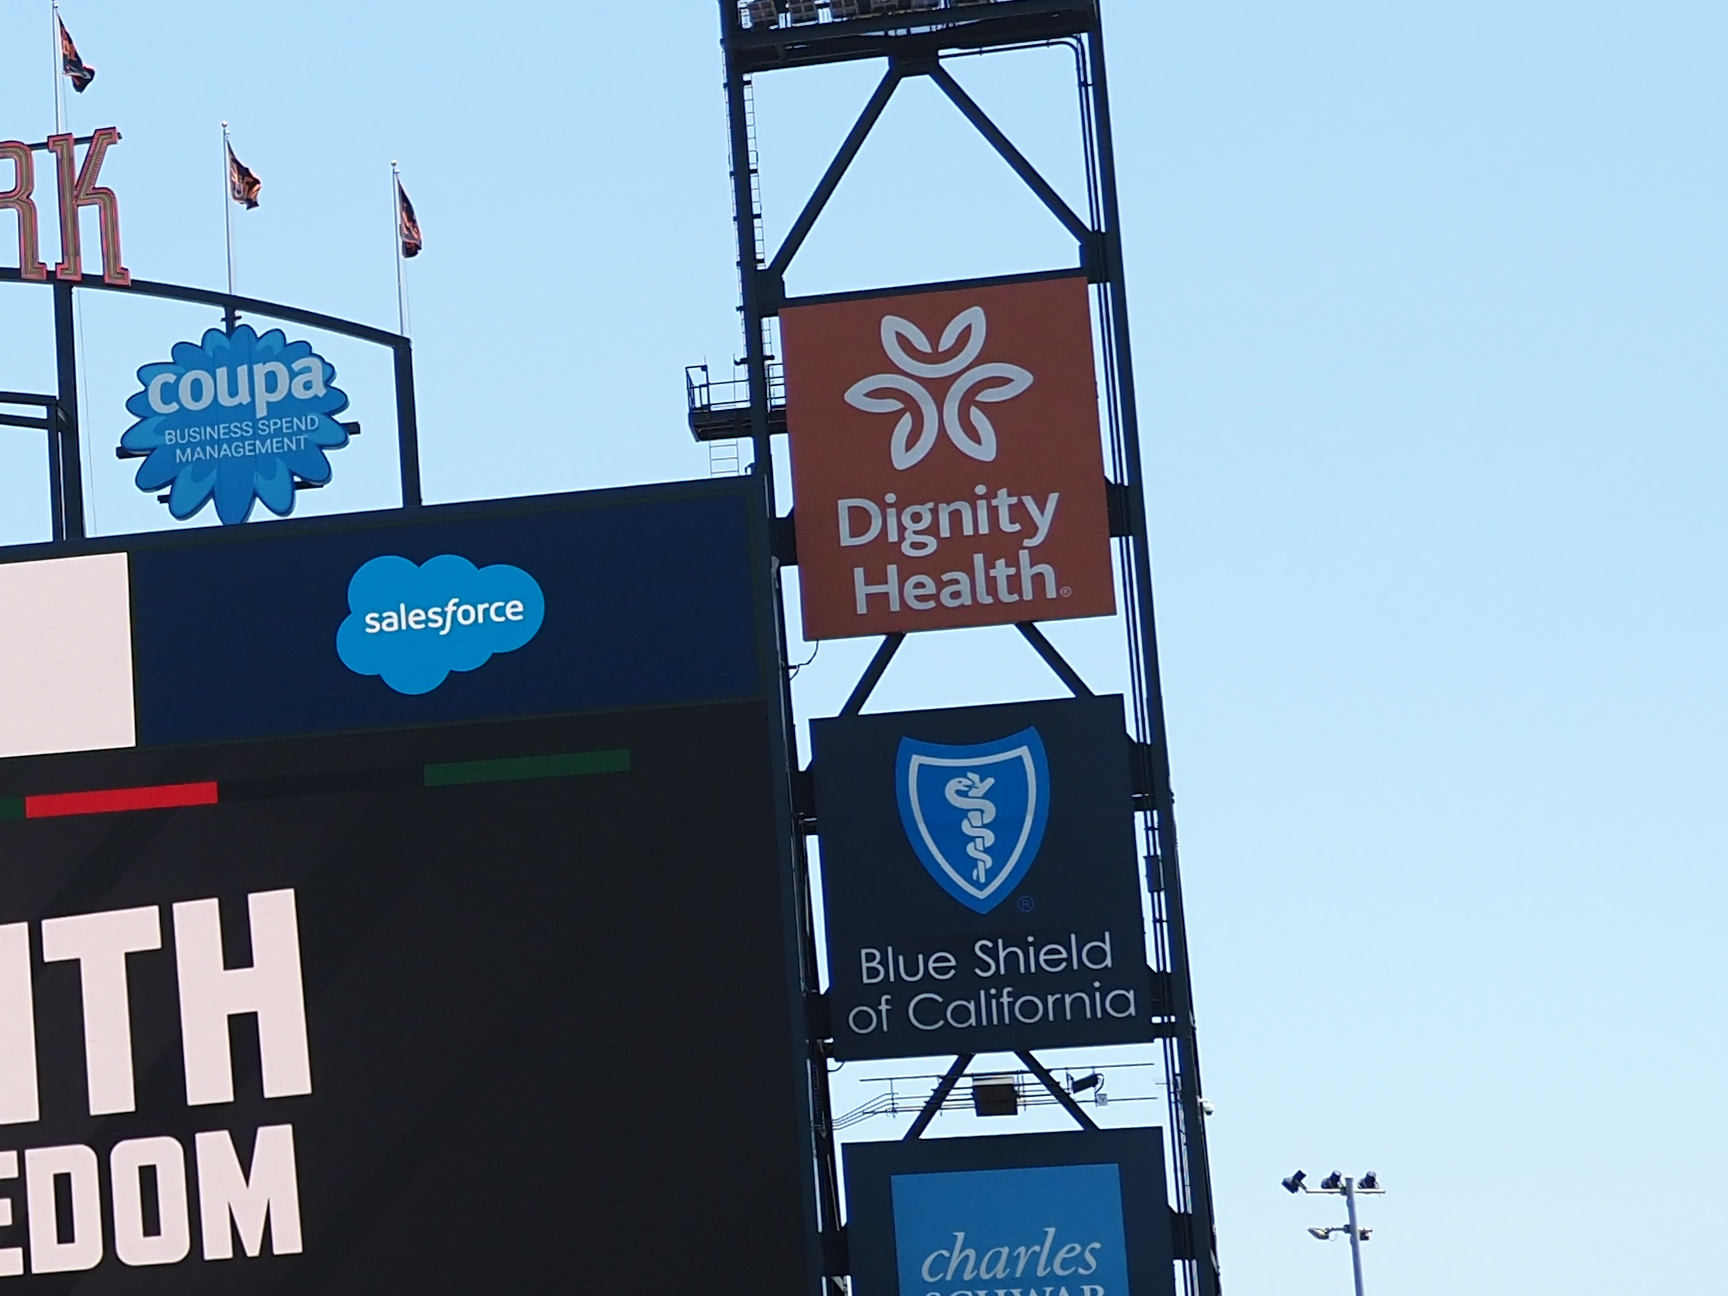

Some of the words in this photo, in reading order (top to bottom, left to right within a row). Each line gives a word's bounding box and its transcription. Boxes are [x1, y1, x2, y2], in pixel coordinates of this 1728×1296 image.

[148, 356, 327, 418] coupa
[165, 422, 253, 445] BUSINESS
[258, 415, 319, 436] SPEND
[176, 435, 308, 464] MANAGEMENT
[837, 484, 1059, 557] Dignity
[853, 549, 1058, 616] Health
[365, 597, 524, 635] salesforce
[859, 944, 957, 985] Blue
[973, 931, 1113, 978] Shield
[847, 993, 893, 1034] of
[907, 980, 1137, 1031] California
[920, 1227, 1102, 1284] charles
